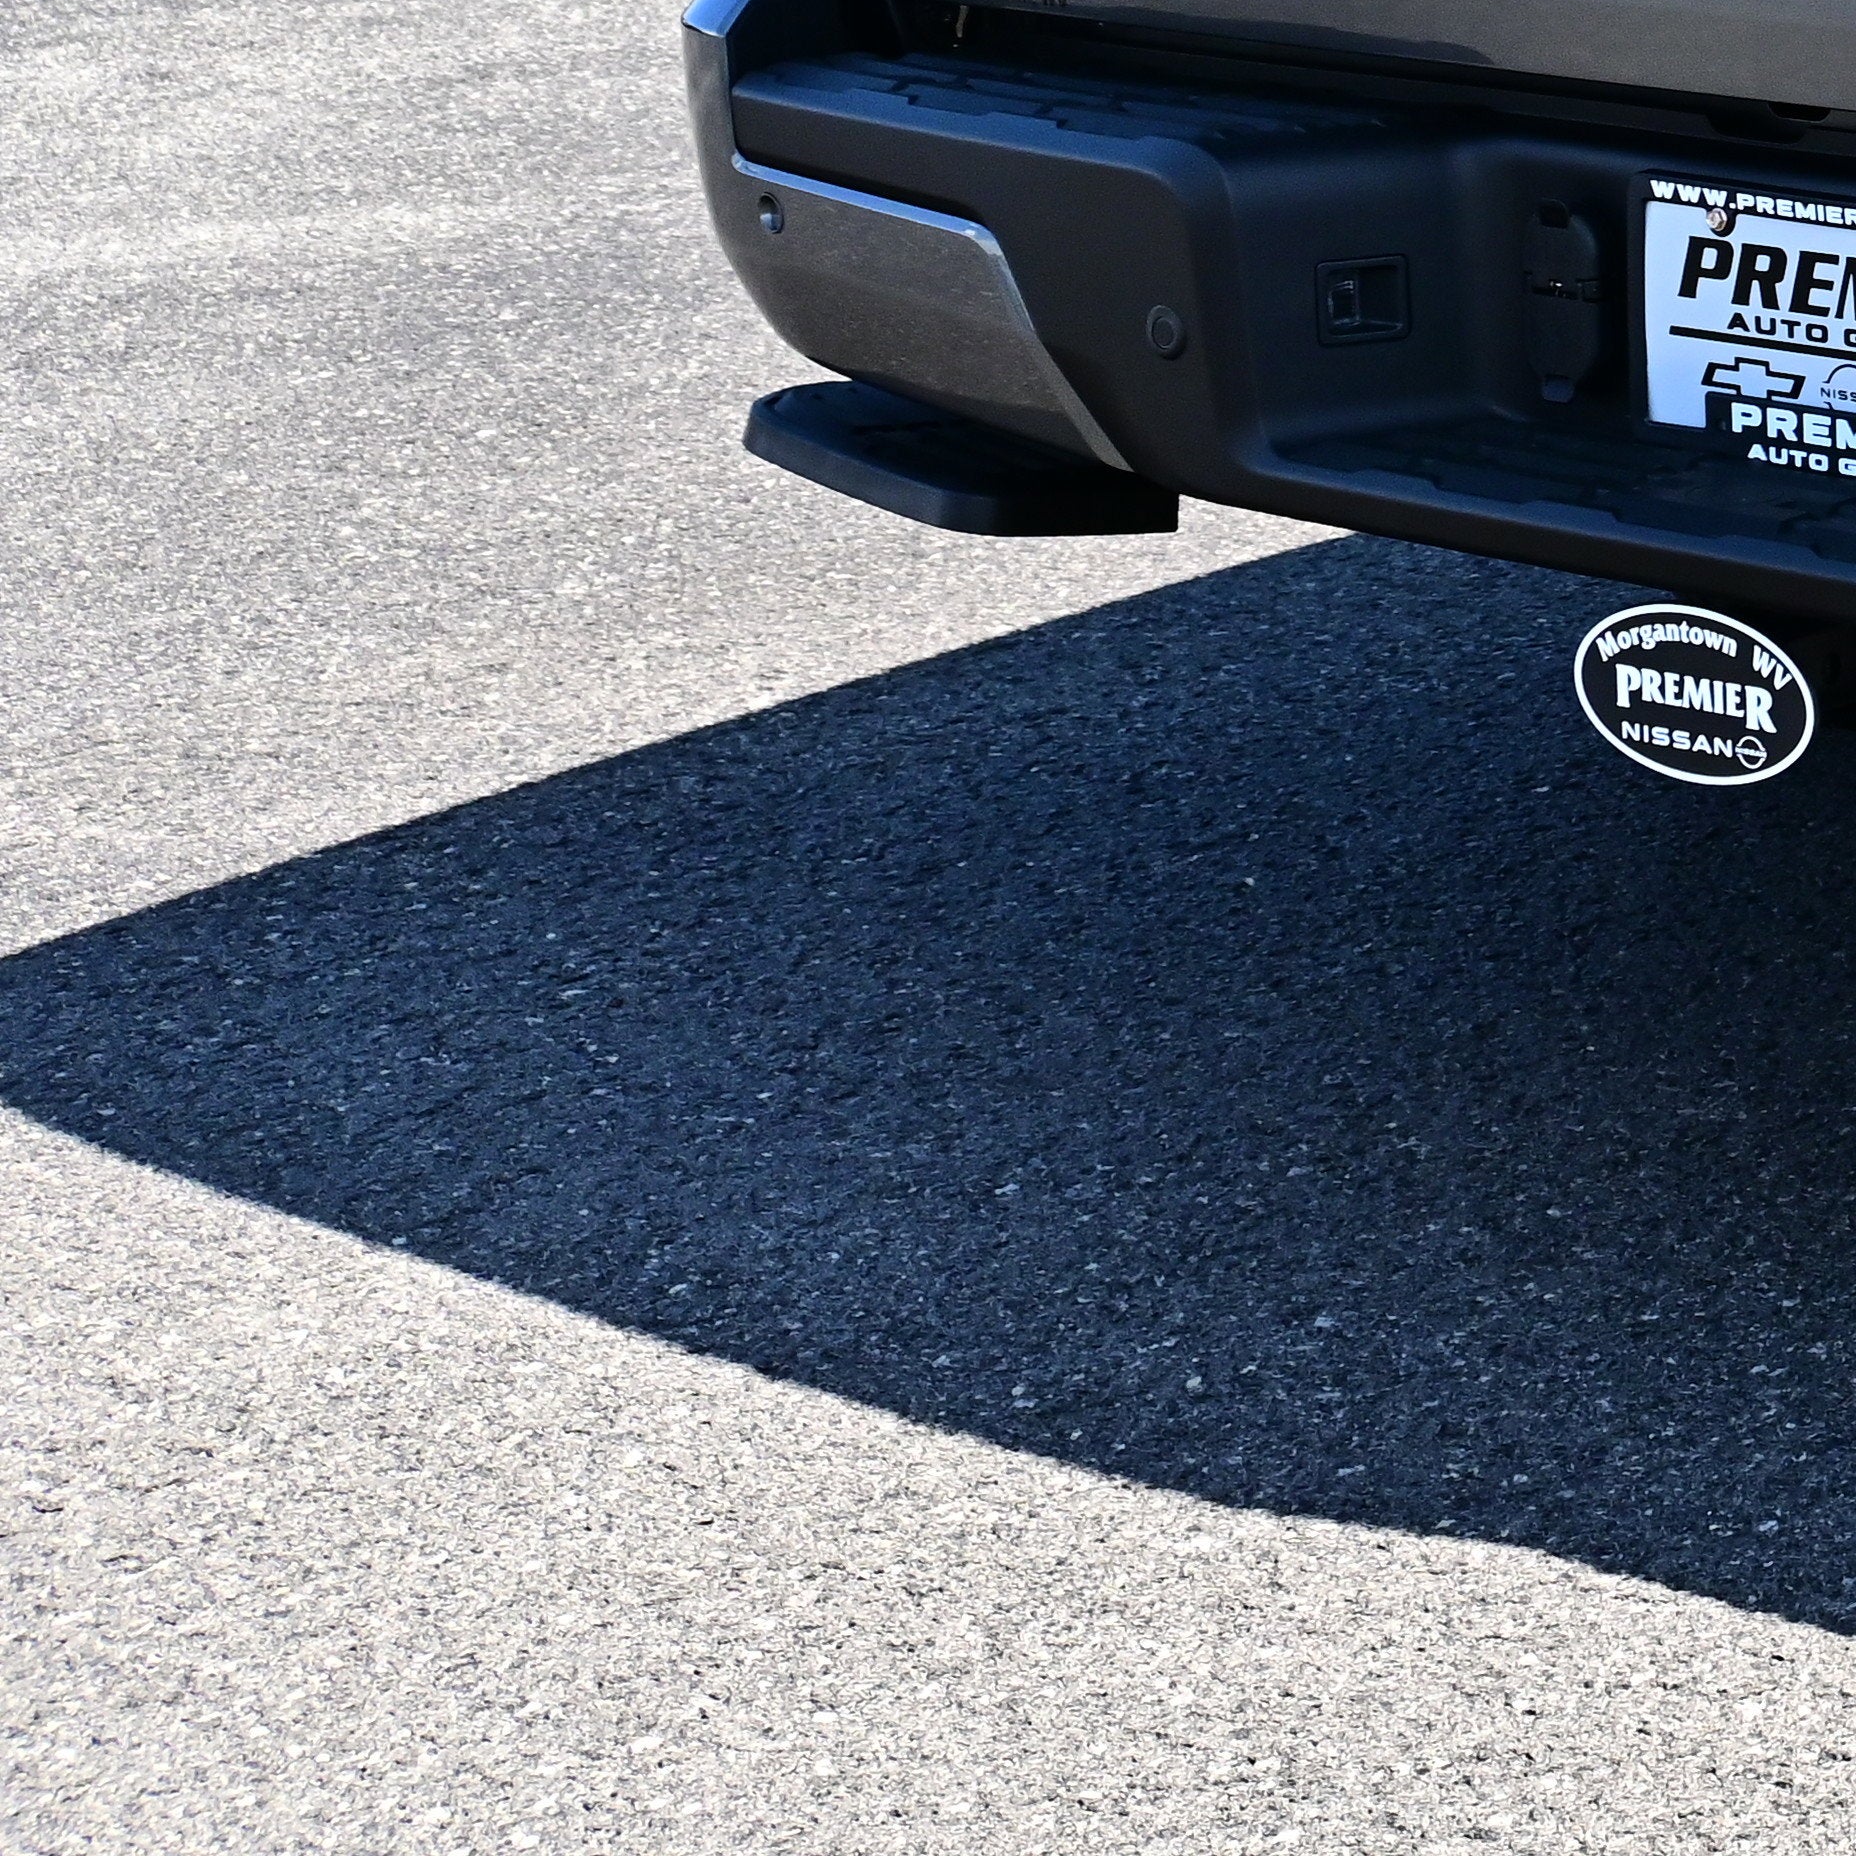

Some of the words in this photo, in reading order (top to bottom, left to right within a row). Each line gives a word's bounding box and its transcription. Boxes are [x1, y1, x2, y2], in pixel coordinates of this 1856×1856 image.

[1727, 312, 1829, 344] AUTO
[1747, 444, 1829, 472] AUTO
[1595, 620, 1738, 662] Morgantown
[1752, 644, 1793, 691] WV
[1615, 663, 1777, 733] PREMIER
[1621, 721, 1733, 758] NISSAN
